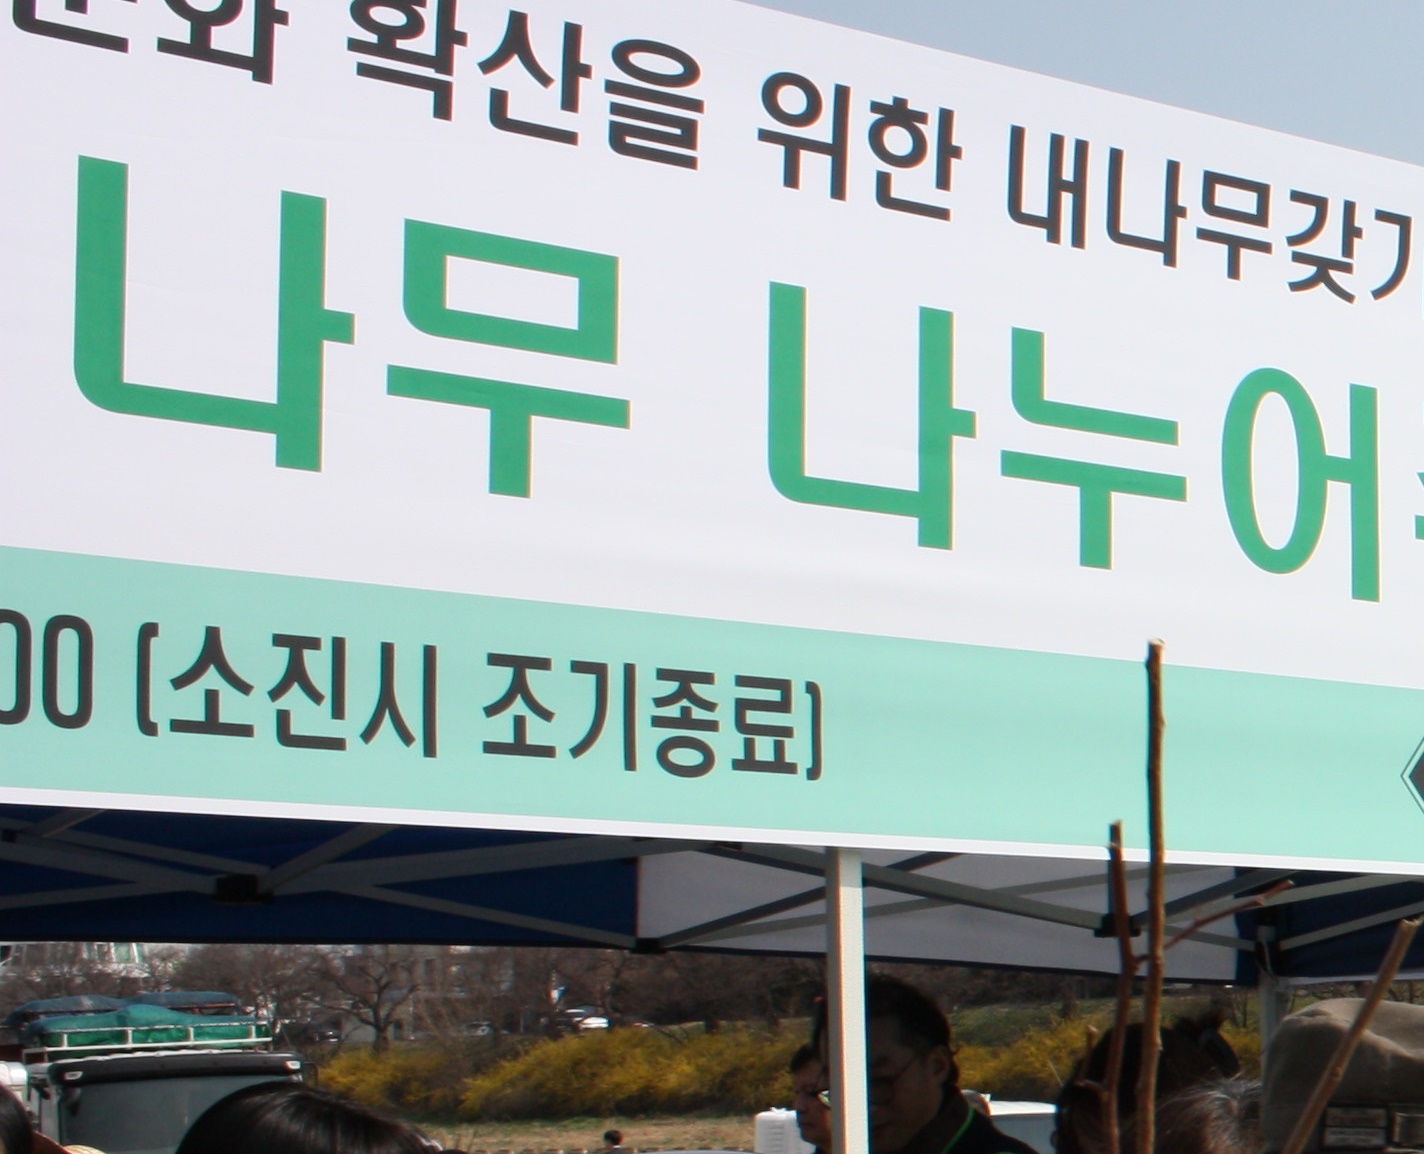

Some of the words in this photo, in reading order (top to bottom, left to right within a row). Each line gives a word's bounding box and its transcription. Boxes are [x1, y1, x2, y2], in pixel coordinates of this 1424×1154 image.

[346, 0, 705, 171] 확산을
[757, 71, 963, 222] 위한
[73, 154, 631, 500] 나무
[136, 622, 438, 759] (소진시
[482, 651, 823, 781] 조기종료)
